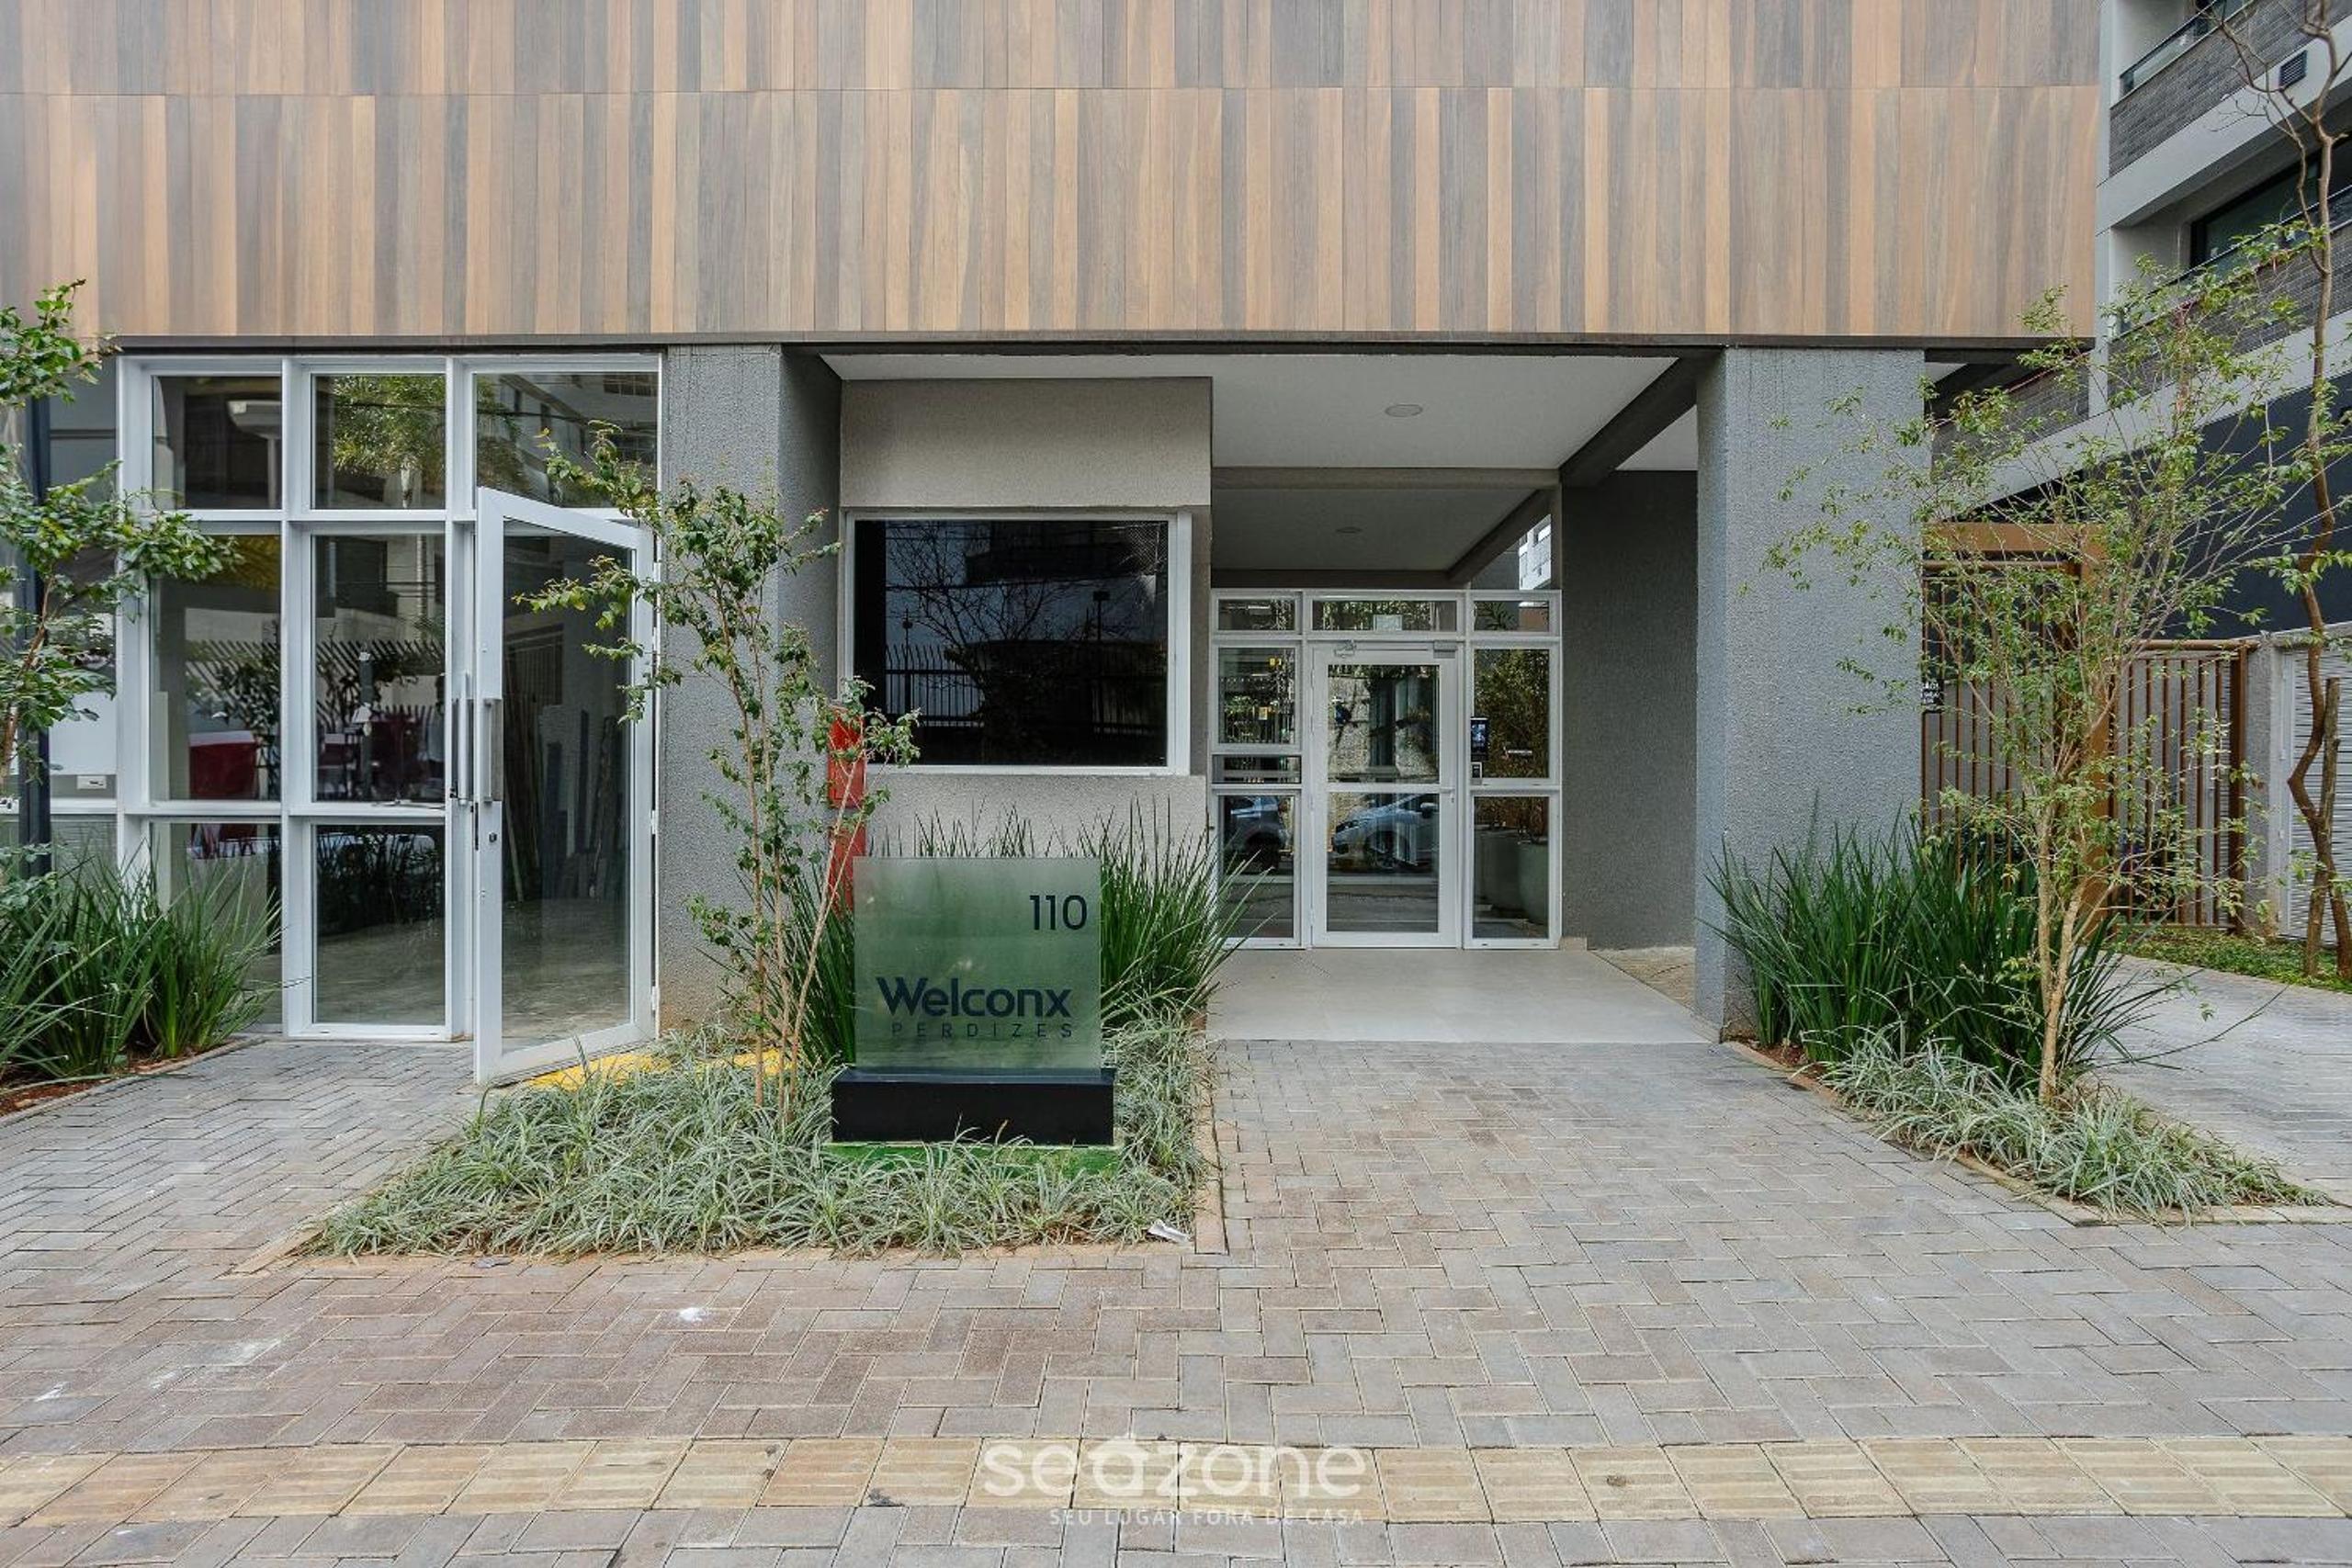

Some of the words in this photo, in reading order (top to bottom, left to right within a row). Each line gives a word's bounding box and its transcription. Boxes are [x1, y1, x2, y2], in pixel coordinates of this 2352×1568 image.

[1029, 895, 1088, 931] 110
[876, 976, 1072, 1019] Welconx
[891, 1022, 1073, 1039] PERDIZES
